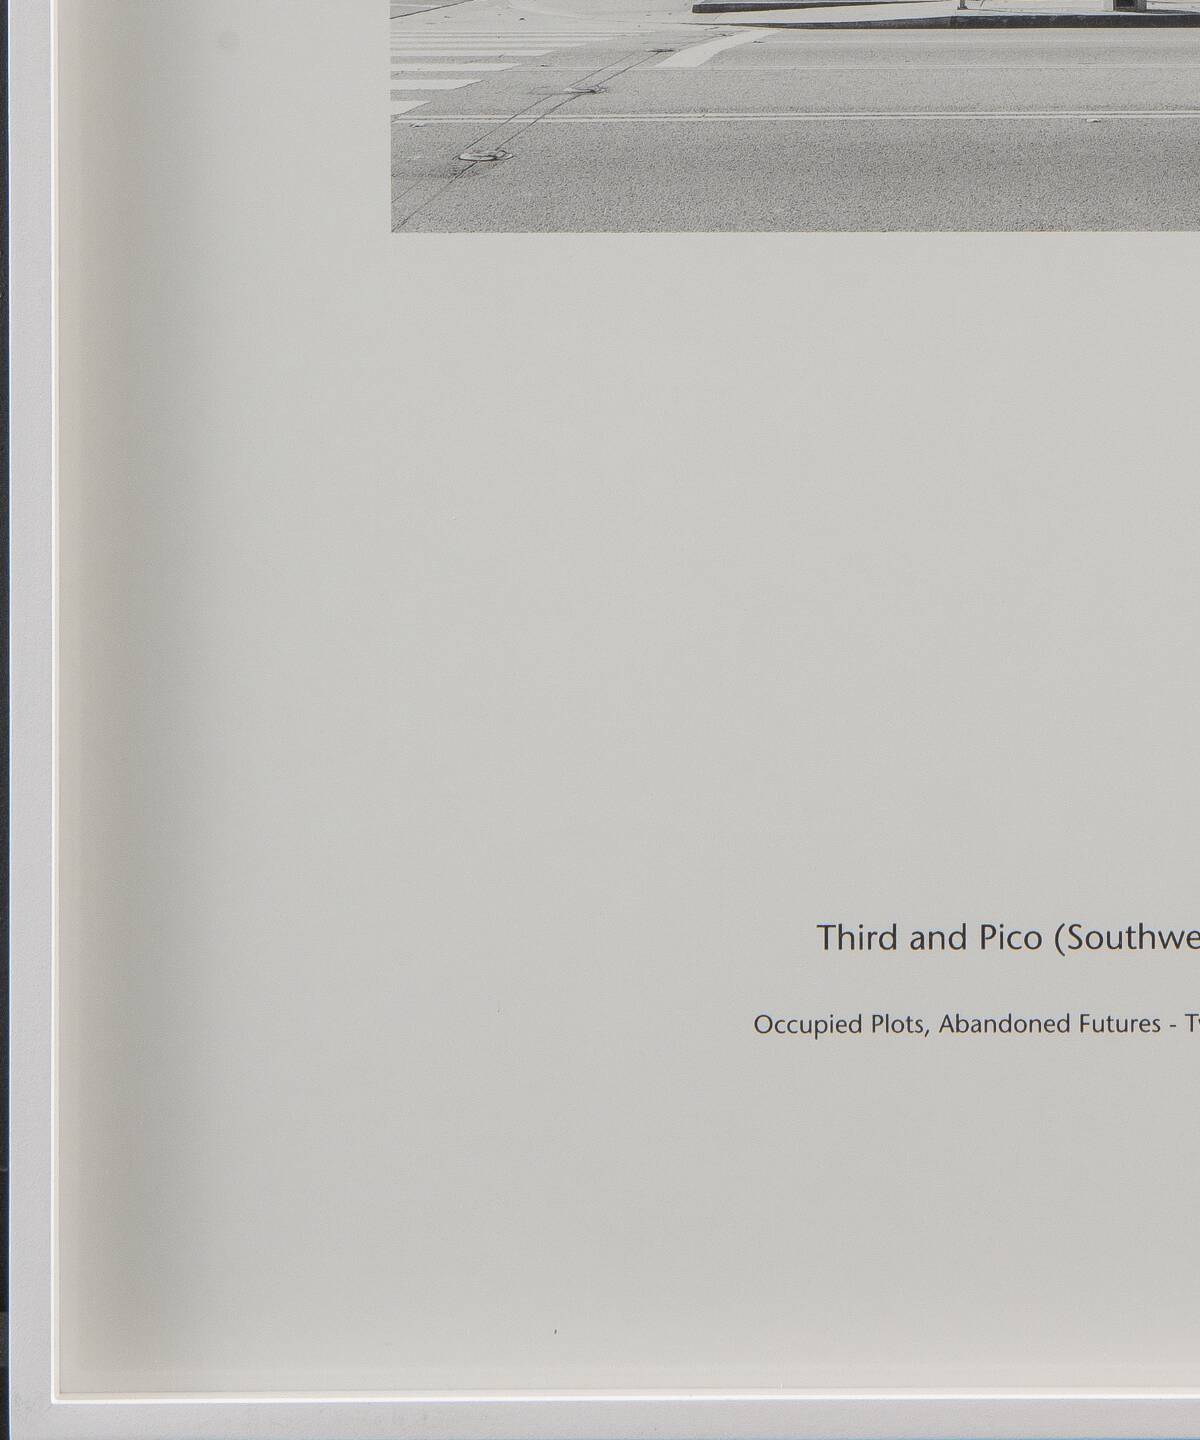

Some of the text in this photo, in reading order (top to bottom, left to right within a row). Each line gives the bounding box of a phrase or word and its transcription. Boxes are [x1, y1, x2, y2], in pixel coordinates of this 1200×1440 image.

[816, 923, 897, 951] Third
[909, 922, 967, 951] and
[980, 923, 1043, 951] Pico
[753, 1013, 862, 1041] Occupied
[871, 1013, 930, 1038] Plots,
[938, 1012, 1070, 1034] Abandoned
[1080, 1013, 1161, 1034] Futures
